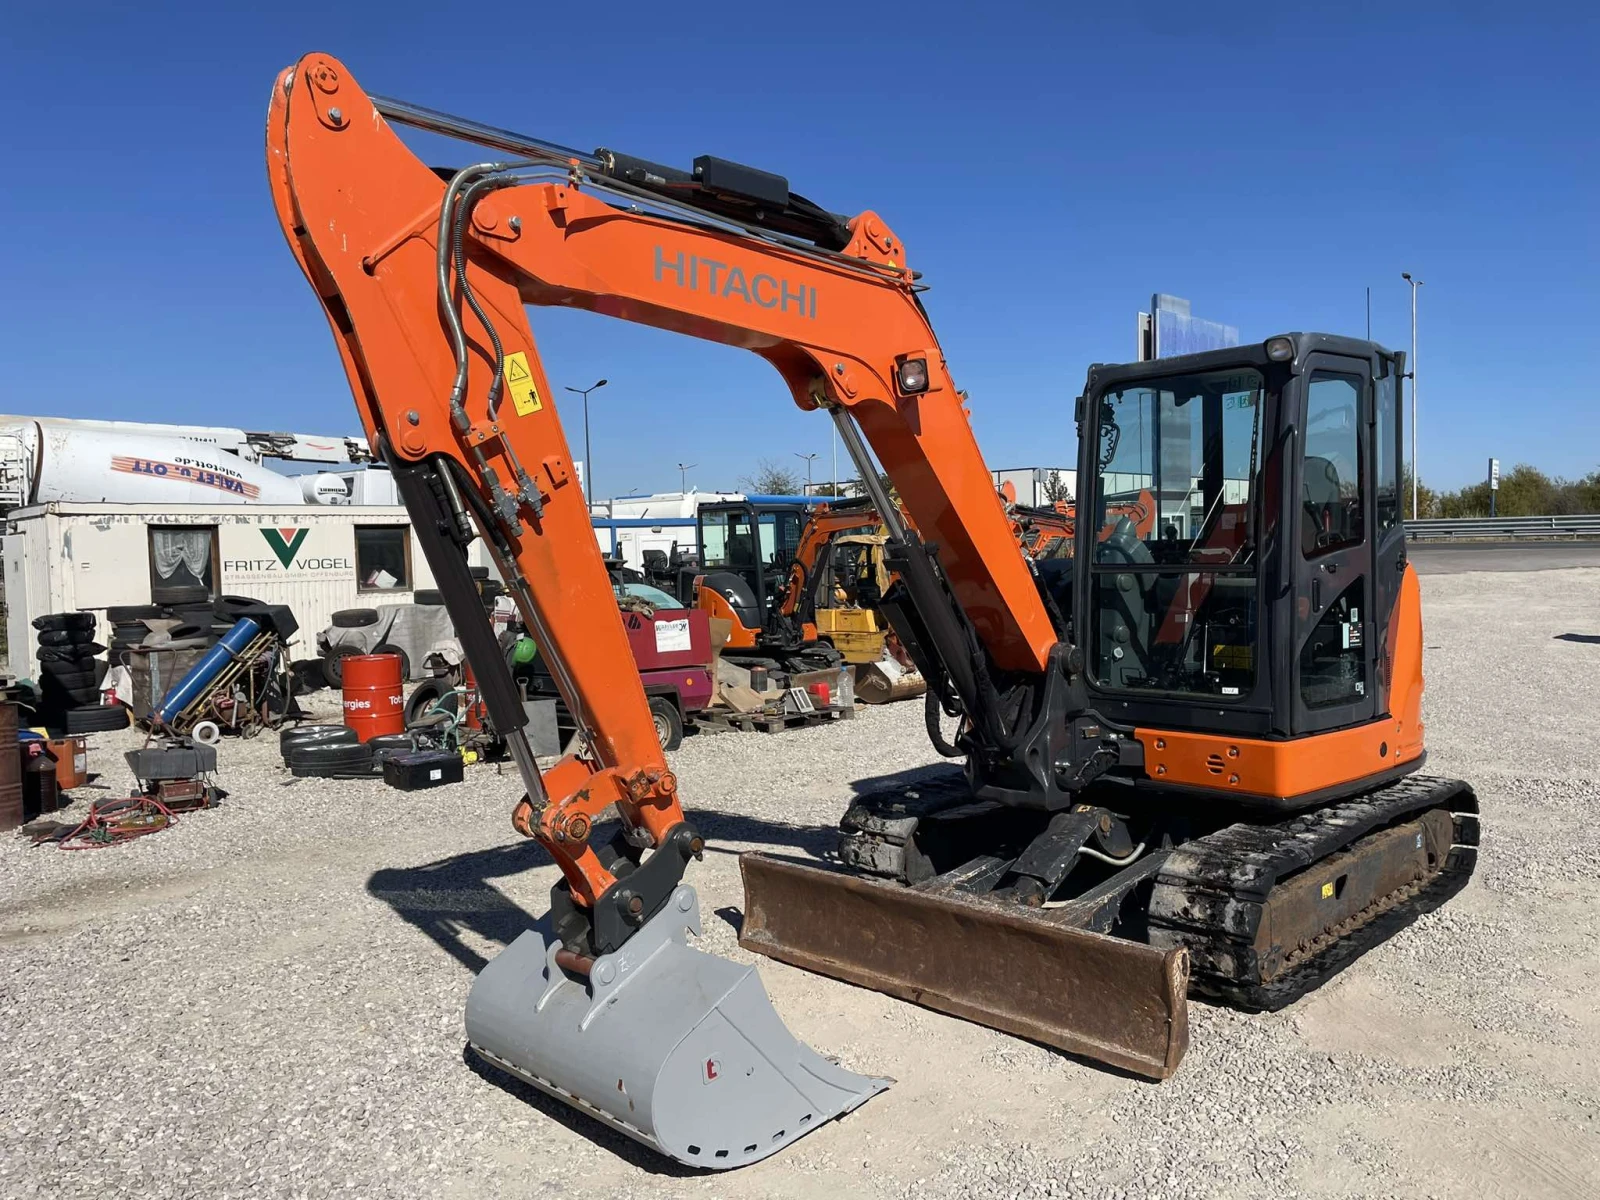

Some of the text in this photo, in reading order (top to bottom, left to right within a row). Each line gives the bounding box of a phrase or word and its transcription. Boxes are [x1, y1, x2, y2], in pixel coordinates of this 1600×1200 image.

[653, 245, 817, 320] HITACHI
[131, 460, 168, 476] OTT
[174, 456, 243, 479] valetott.de
[196, 471, 244, 494] VALET
[224, 558, 353, 572] FRITZ VOGEL
